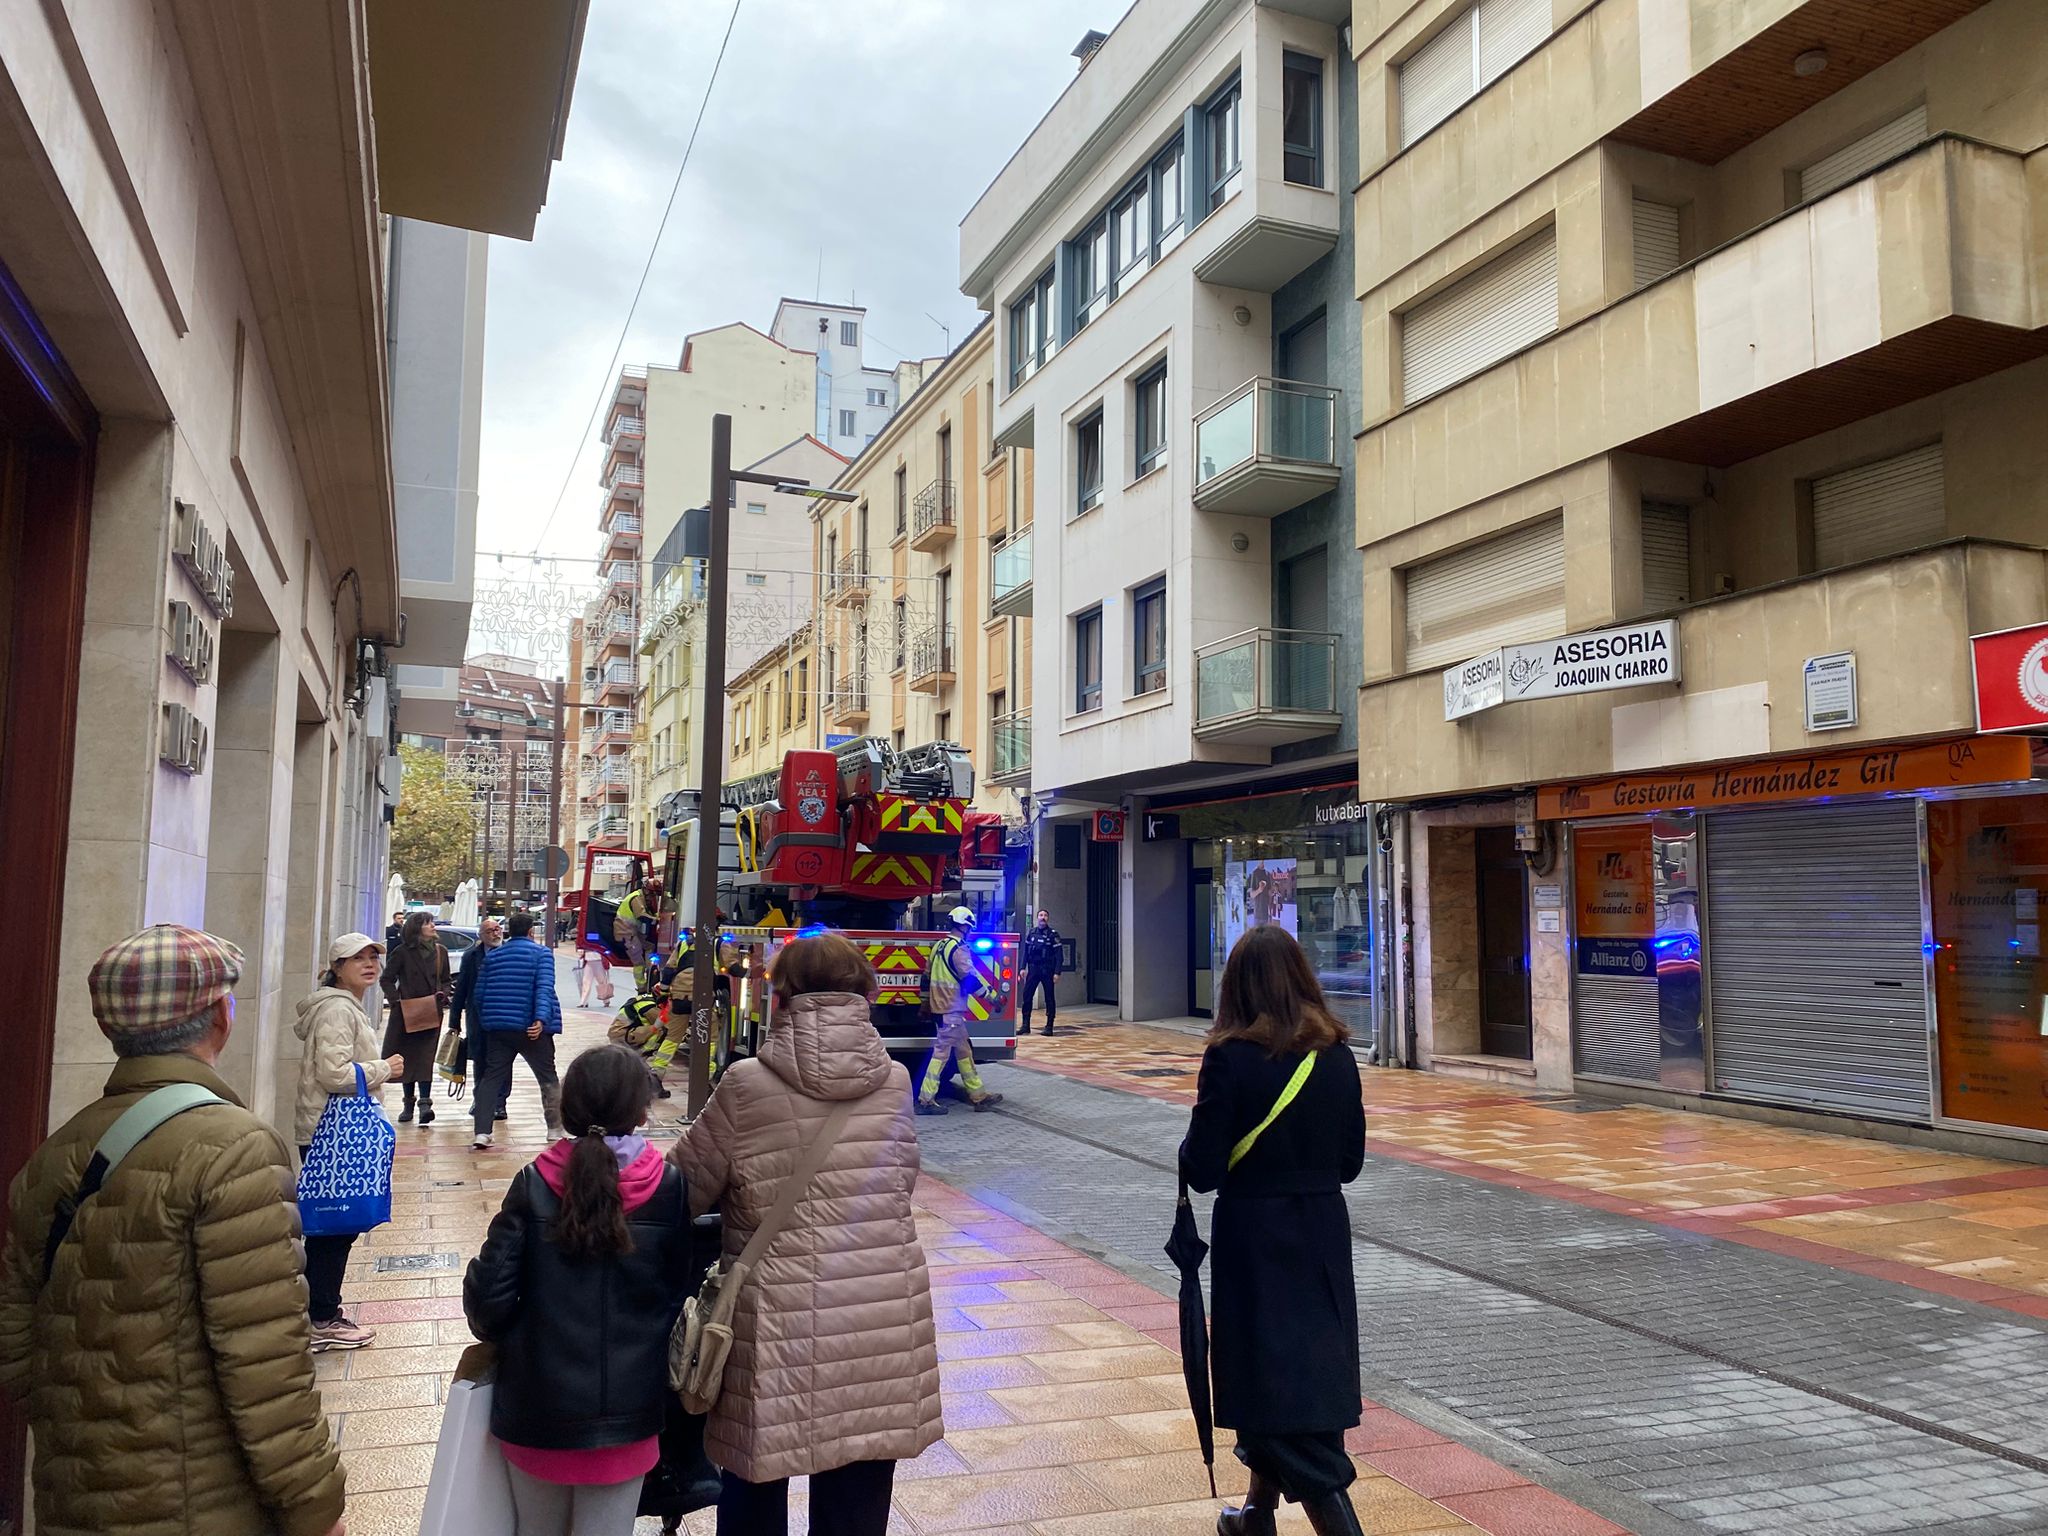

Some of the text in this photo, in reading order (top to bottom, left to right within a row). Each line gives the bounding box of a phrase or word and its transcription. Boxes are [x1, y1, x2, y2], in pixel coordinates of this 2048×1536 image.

[1553, 629, 1667, 665] ASESORIA
[1462, 656, 1501, 688] ASESORIA
[1554, 657, 1668, 688] JOAQUIN CHARRO
[1614, 752, 1899, 806] Gestoría Hernández Gil
[797, 788, 828, 797] AEA 1
[1315, 801, 1368, 822] kutxaban
[800, 861, 817, 869] 112
[1948, 891, 2018, 906] Hernánde
[1586, 902, 1648, 915] Hernández Gil
[1591, 952, 1630, 967] Allianz
